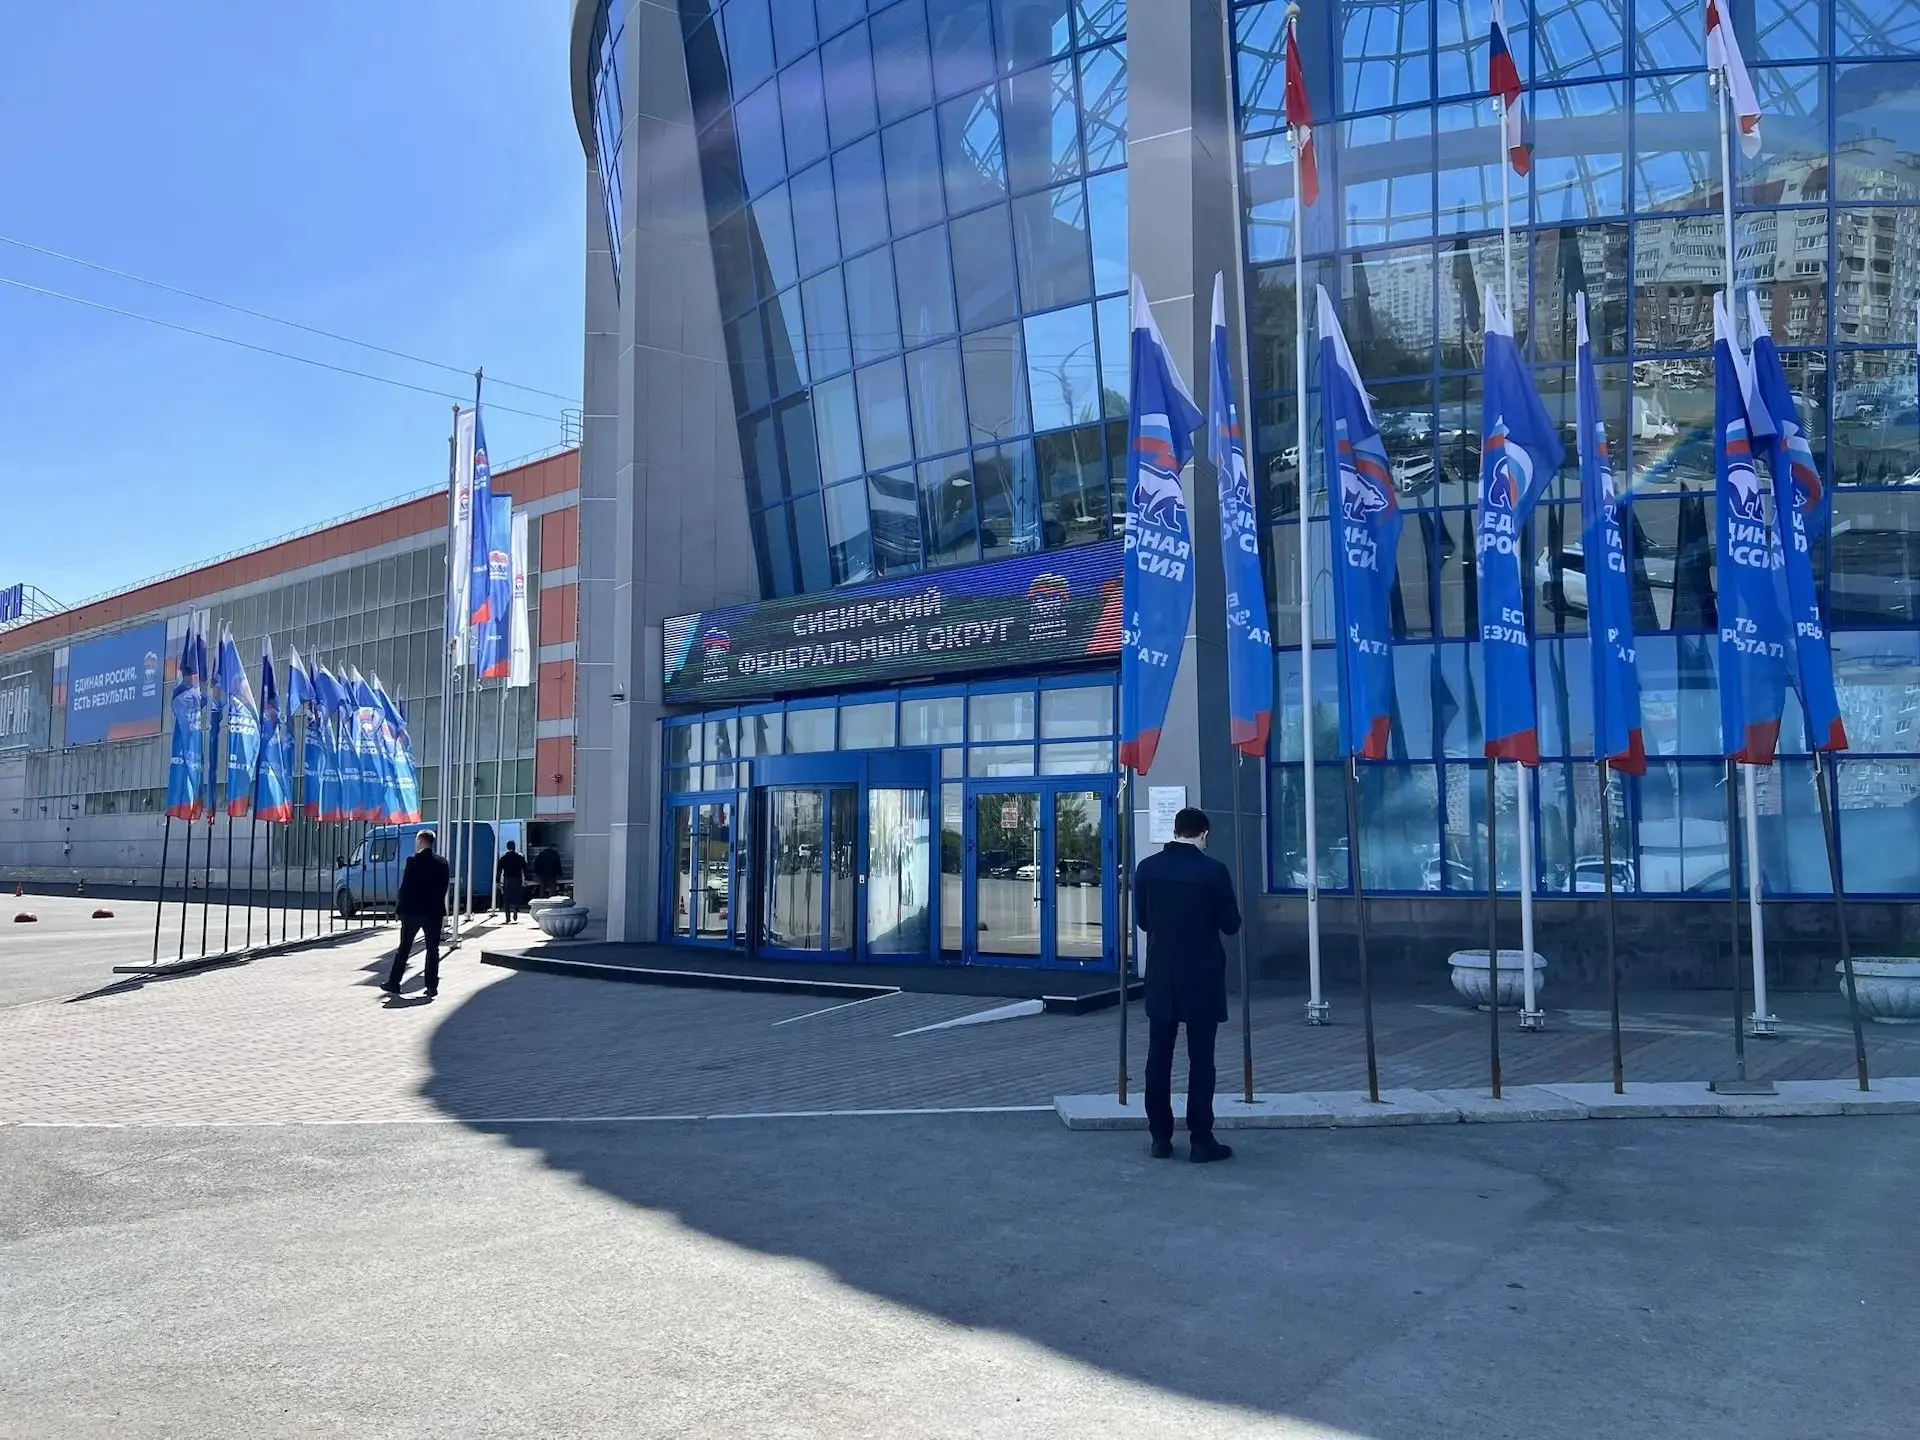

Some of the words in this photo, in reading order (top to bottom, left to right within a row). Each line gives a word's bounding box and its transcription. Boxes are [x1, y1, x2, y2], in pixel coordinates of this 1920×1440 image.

[792, 586, 942, 638] СИБИРСКИЙ
[736, 626, 920, 676] ФЕДЕРАЛЬНЫЙ
[925, 616, 1015, 652] ОКРУГ
[73, 695, 91, 711] ЕСТЬ
[91, 685, 136, 708] РЕЗУЛЬТАТ!
[74, 673, 105, 693] ЕДИНАЯ
[104, 666, 138, 686] РОССИЯ.
